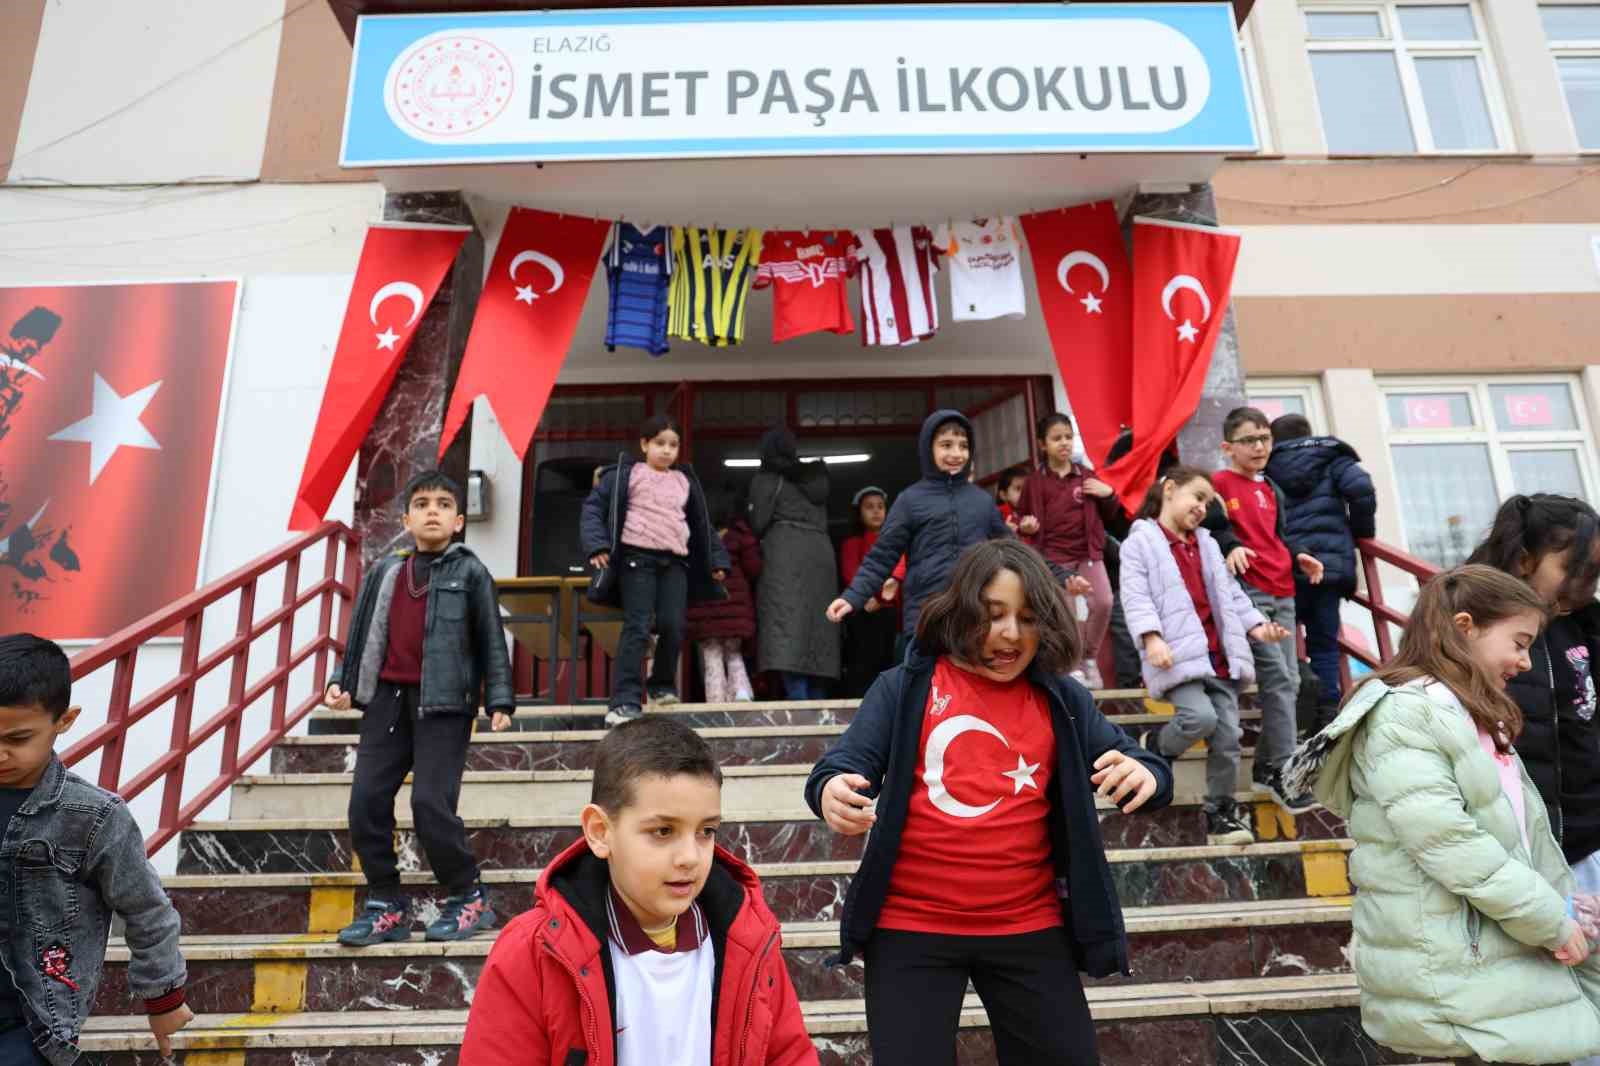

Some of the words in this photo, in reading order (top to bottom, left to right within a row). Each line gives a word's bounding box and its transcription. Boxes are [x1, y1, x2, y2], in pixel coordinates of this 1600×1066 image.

[533, 34, 611, 54] ELAZIĞ
[529, 63, 709, 120] İSMET
[727, 68, 879, 128] PAŞA
[897, 56, 1188, 113] İLKOKULU
